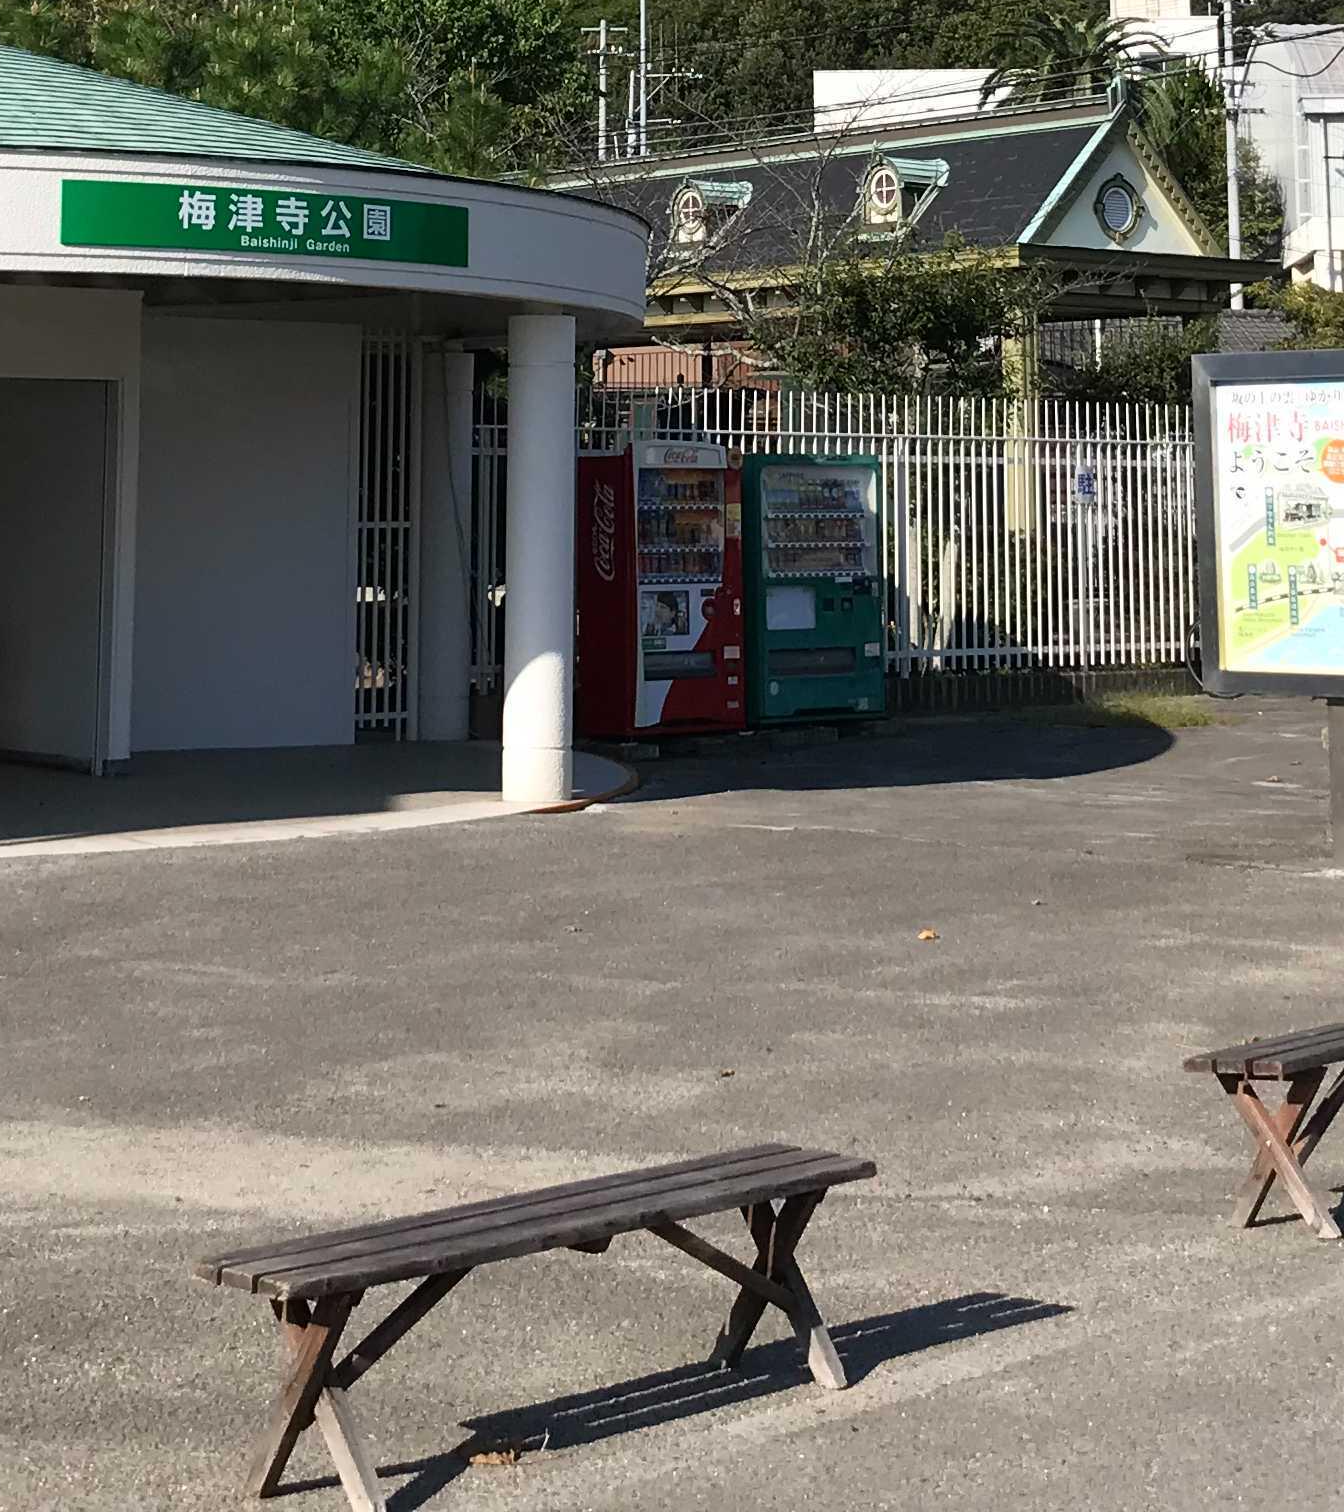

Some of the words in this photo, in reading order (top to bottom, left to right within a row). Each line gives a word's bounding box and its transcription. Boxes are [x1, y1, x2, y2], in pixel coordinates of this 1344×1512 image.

[179, 189, 391, 241] 梅津寺公園
[240, 235, 298, 250] Baishinji
[306, 239, 350, 253] Garden
[1229, 449, 1314, 473] ようこそ
